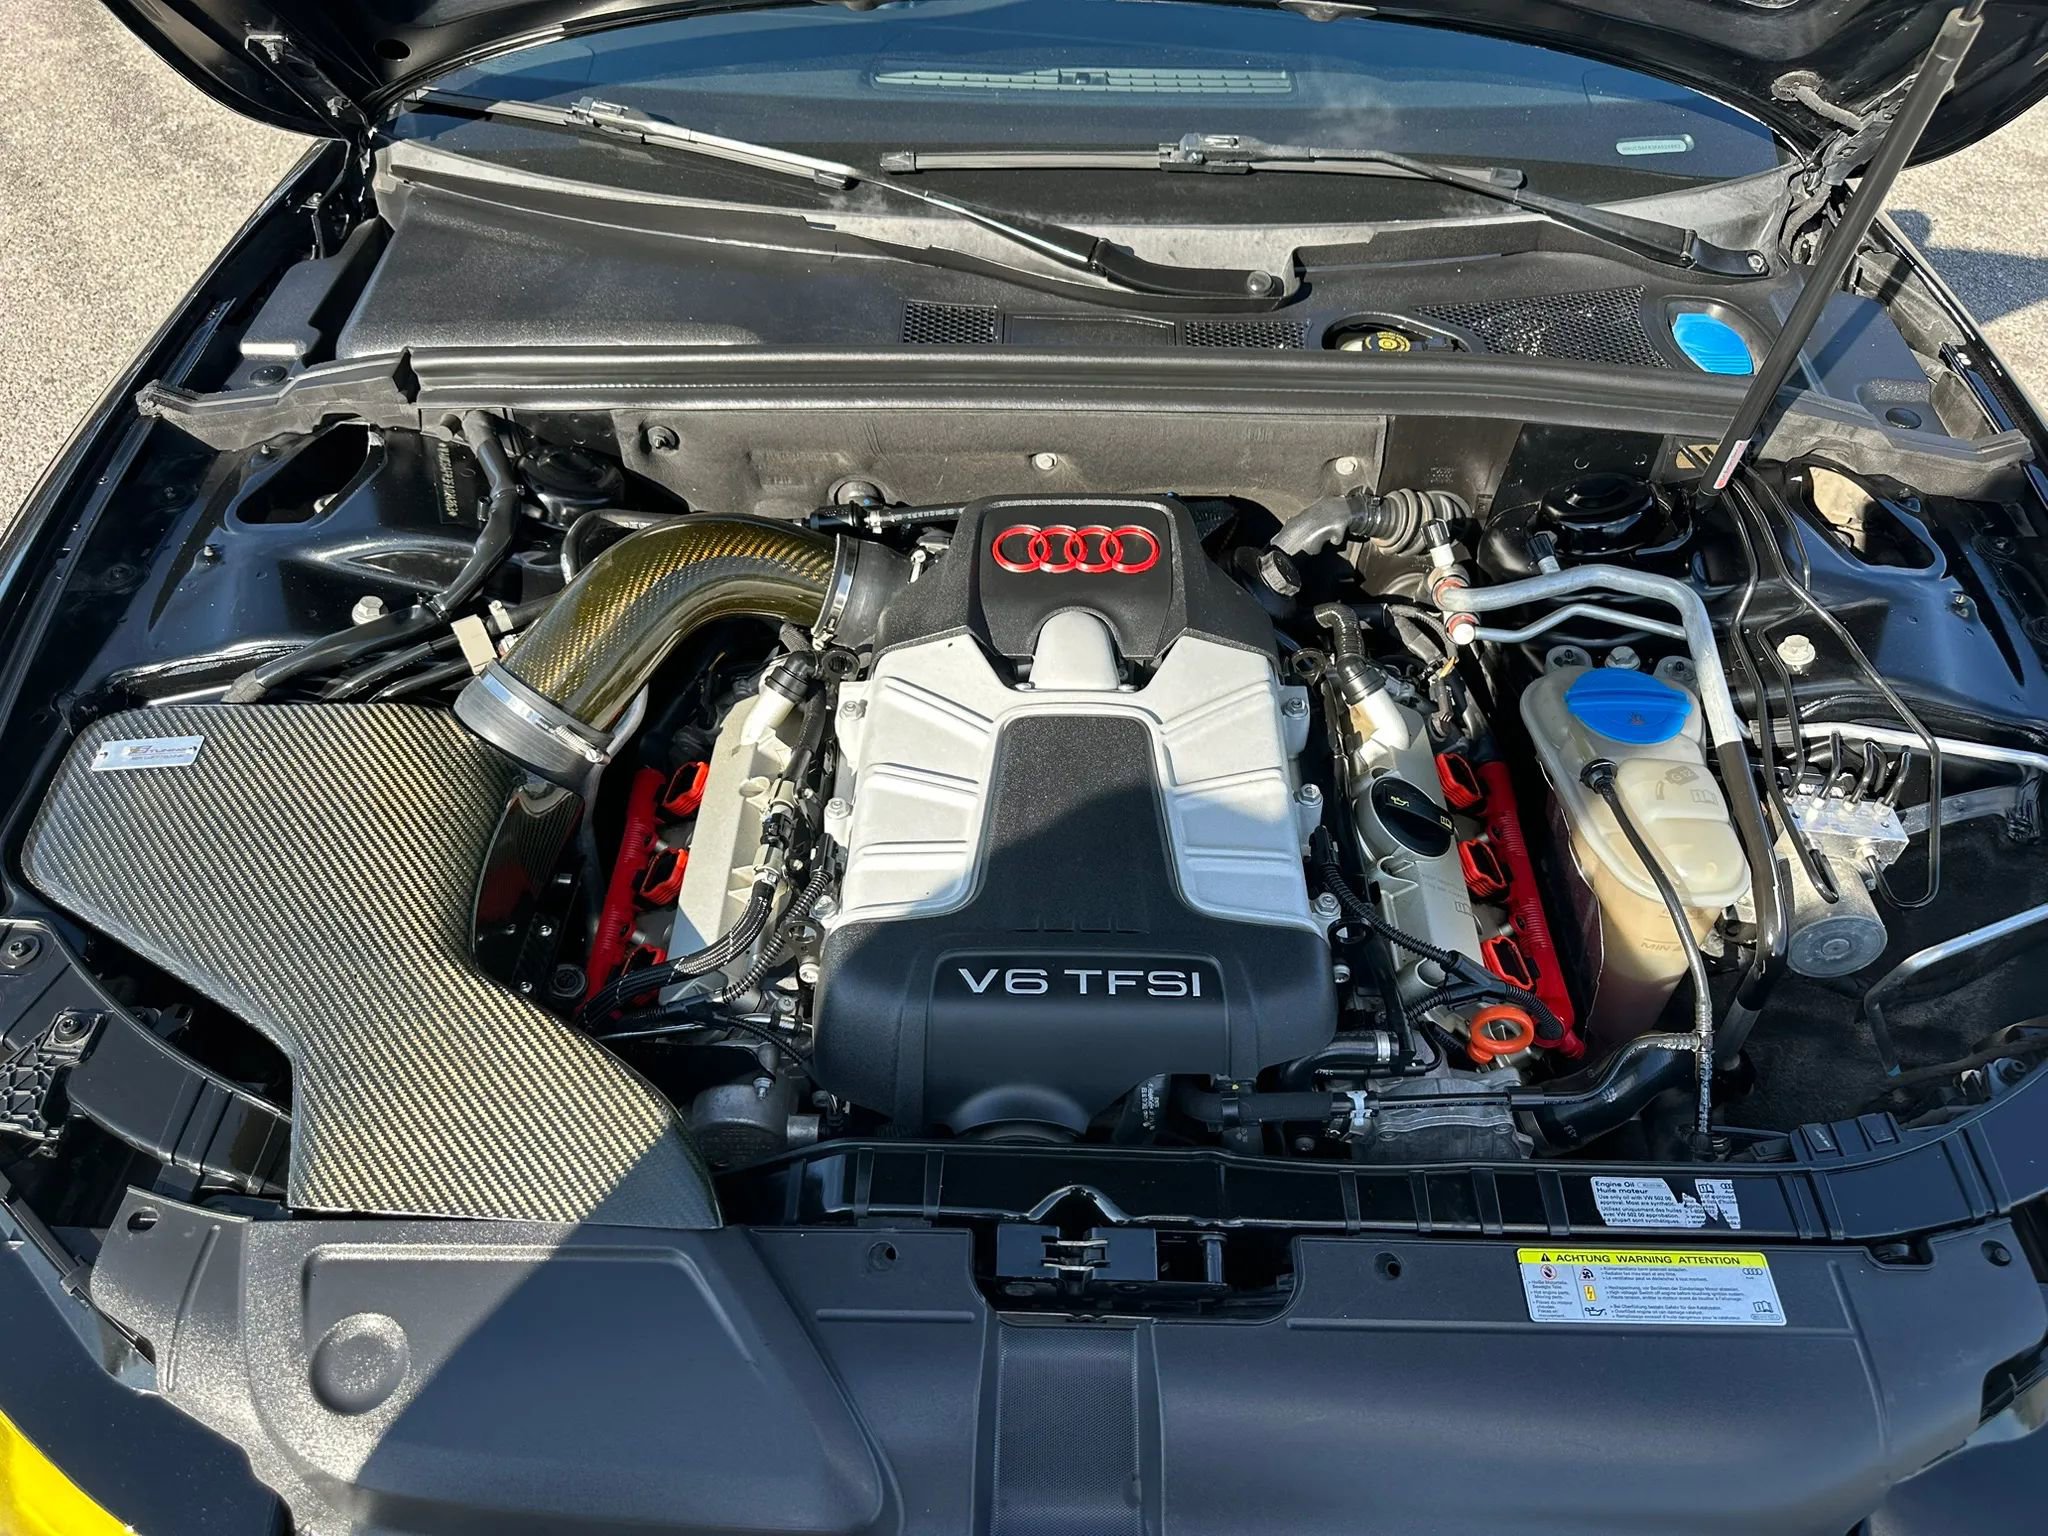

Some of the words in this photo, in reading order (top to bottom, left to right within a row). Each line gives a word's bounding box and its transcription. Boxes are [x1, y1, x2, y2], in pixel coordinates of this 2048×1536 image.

[958, 968, 1049, 994] V6
[1064, 970, 1200, 997] TFSI
[1556, 1254, 1610, 1263] ACHTUNG
[1678, 1256, 1740, 1264] ATTENTION
